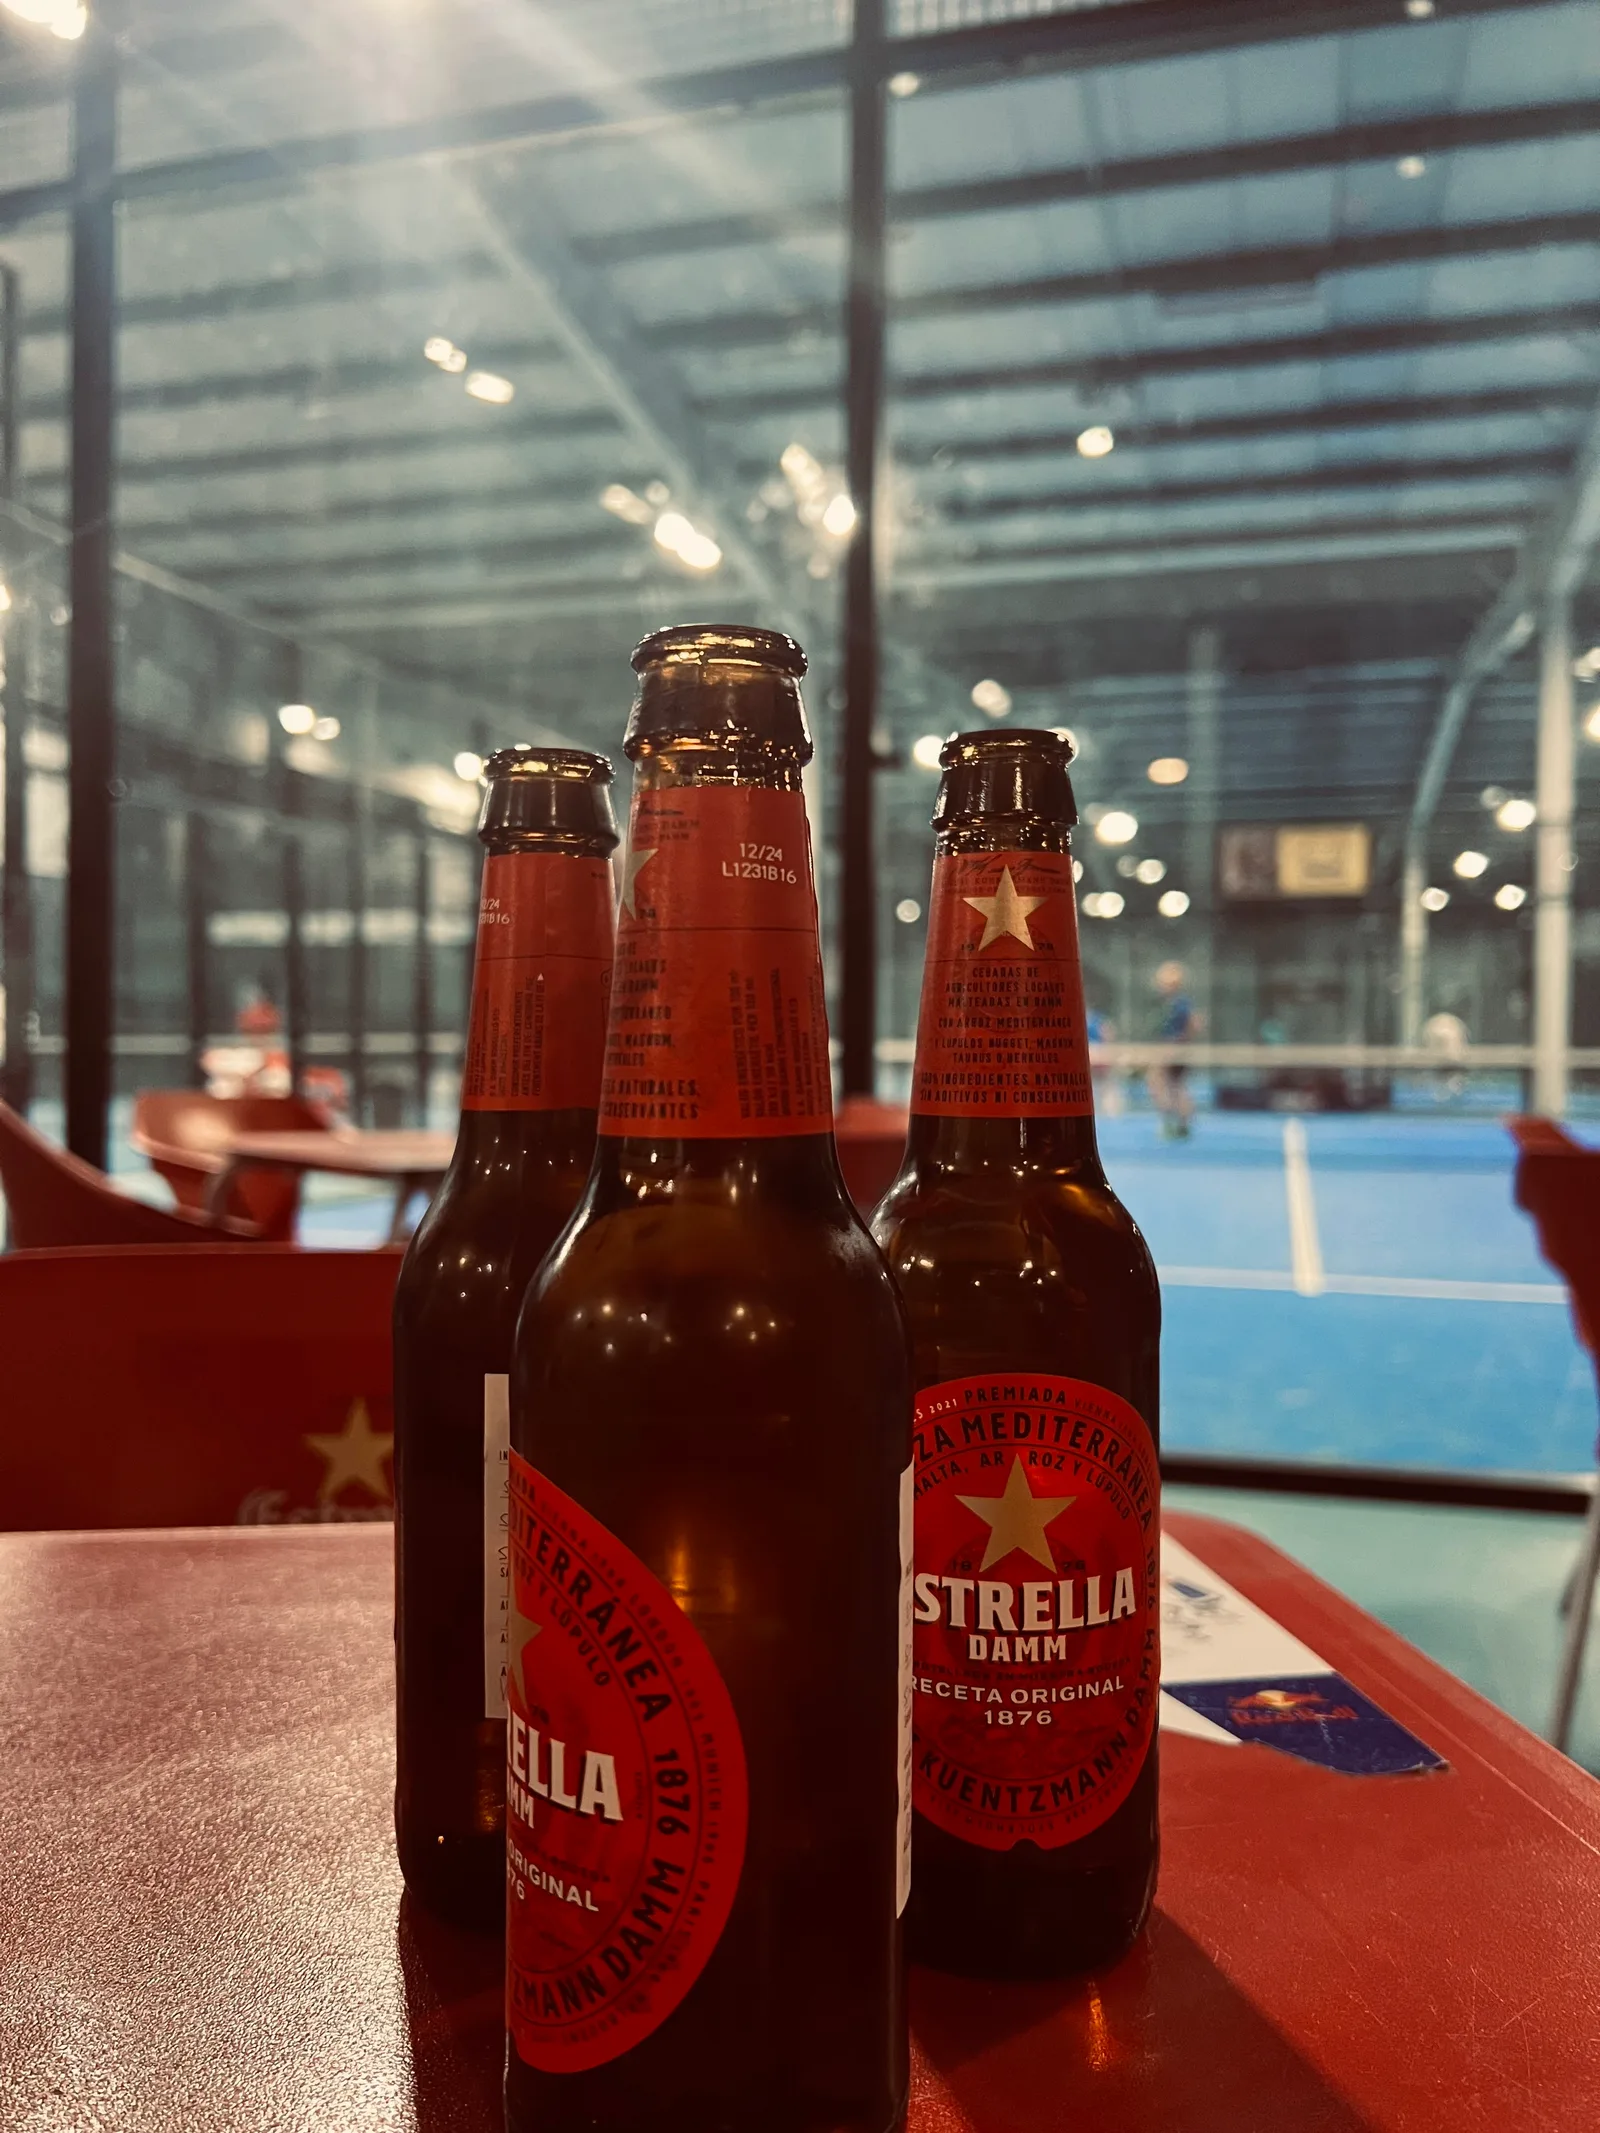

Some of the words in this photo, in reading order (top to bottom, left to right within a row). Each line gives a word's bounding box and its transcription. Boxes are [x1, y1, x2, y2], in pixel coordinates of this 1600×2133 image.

[739, 842, 783, 862] 12/24
[721, 860, 797, 884] L1231B16
[953, 1052, 991, 1064] TAURUS
[941, 1072, 1028, 1086] INGREDIENTES
[934, 1090, 988, 1103] ADITIVOS
[929, 1398, 957, 1414] 2021
[964, 1386, 1066, 1406] PREMIADA
[913, 1424, 957, 1463] ZA
[979, 1451, 1004, 1468] AR
[1028, 1451, 1066, 1471] ROZ
[1073, 1463, 1083, 1477] Y
[914, 1566, 1136, 1632] STRELLA
[968, 1633, 1067, 1662] DAMM
[911, 1674, 1003, 1704] RECETA
[1010, 1675, 1124, 1704] ORIGINAL
[984, 1709, 1052, 1726] 1876
[508, 1699, 624, 1823] ELLA
[919, 1731, 1129, 1813] KUENTZMANN
[508, 1770, 535, 1830] MM
[654, 1748, 691, 1836] 1876
[508, 1858, 525, 1902] 76
[599, 1856, 685, 1982] DAMM
